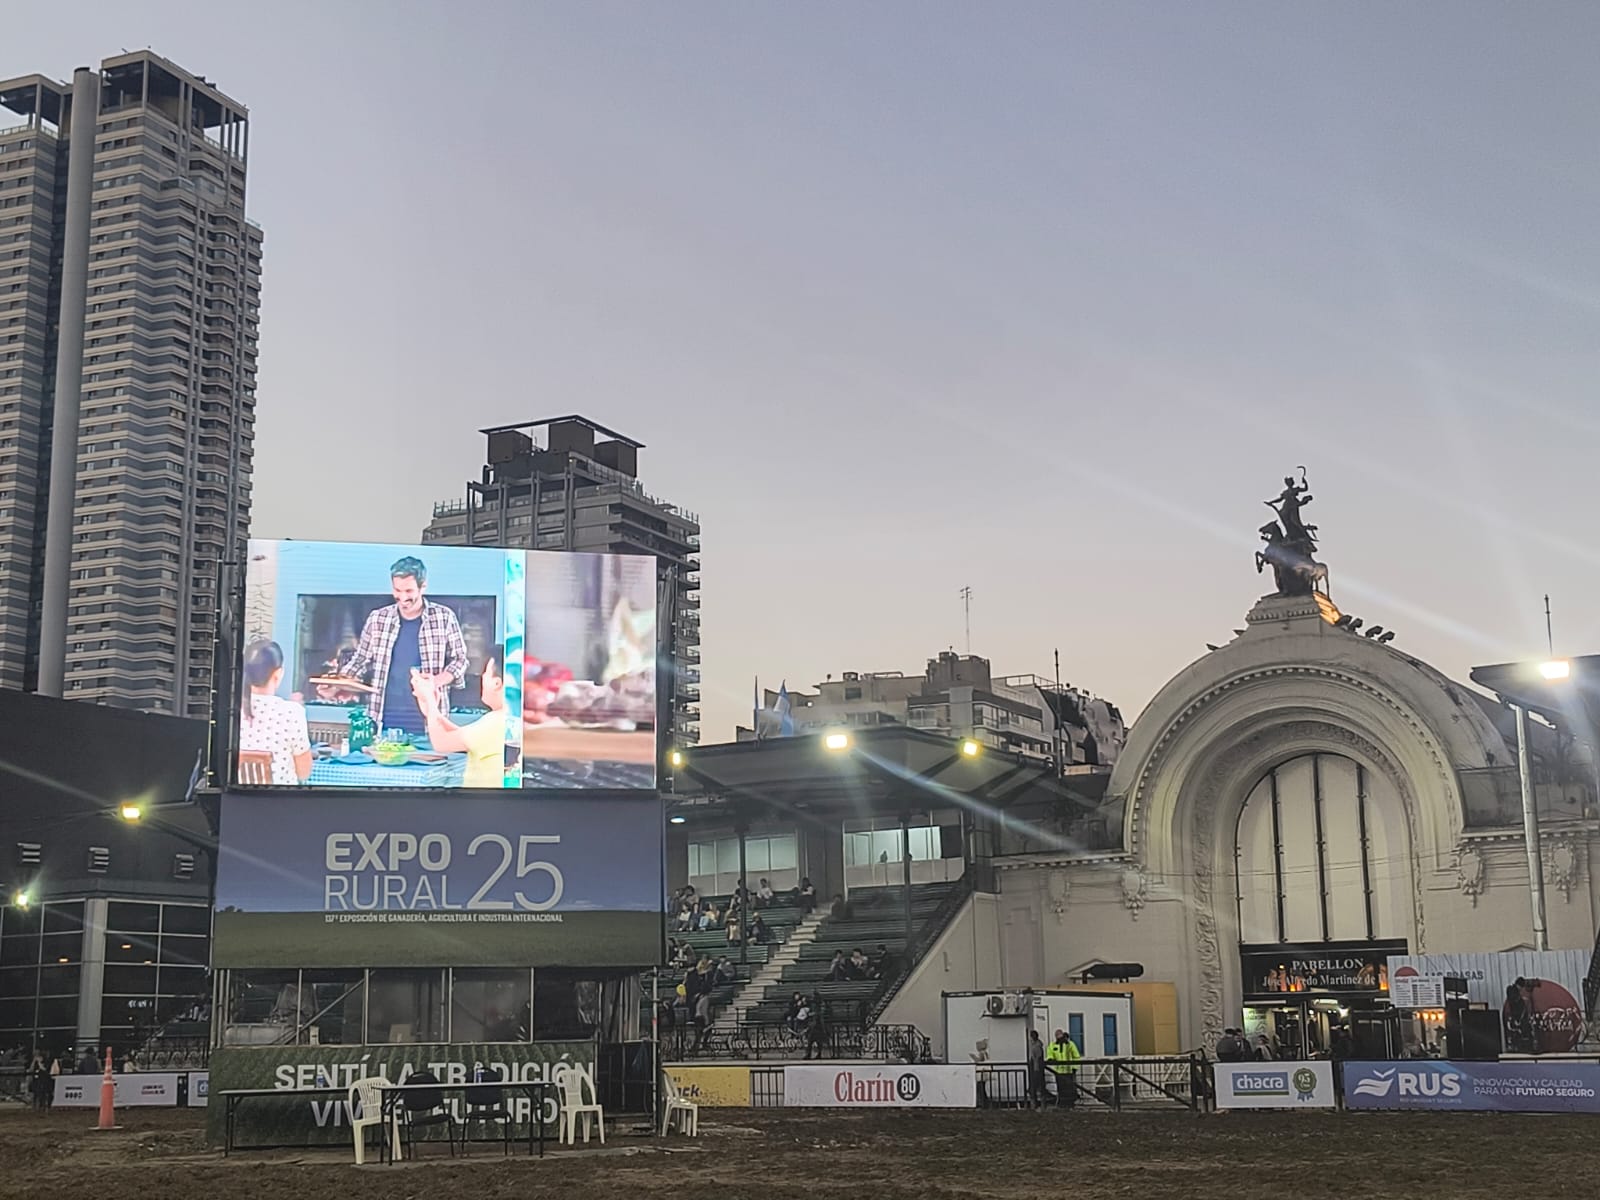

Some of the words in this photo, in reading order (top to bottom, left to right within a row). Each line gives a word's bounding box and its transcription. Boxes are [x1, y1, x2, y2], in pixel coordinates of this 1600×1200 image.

[325, 832, 452, 872] EXPO
[466, 833, 564, 910] 25
[324, 874, 463, 910] RURAL
[1292, 959, 1364, 970] PABELLON
[834, 1071, 896, 1102] Clarín
[901, 1077, 916, 1094] 80
[1236, 1074, 1284, 1089] chacra
[1398, 1072, 1461, 1097] RUS
[1473, 1078, 1532, 1087] INNOVACIÓN
[1532, 1079, 1540, 1087] Y
[1540, 1079, 1583, 1088] CALIDAD
[1473, 1086, 1500, 1095] PARA
[1500, 1087, 1515, 1096] UN
[1515, 1087, 1554, 1097] FUTURO
[1555, 1088, 1596, 1098] SEGURO
